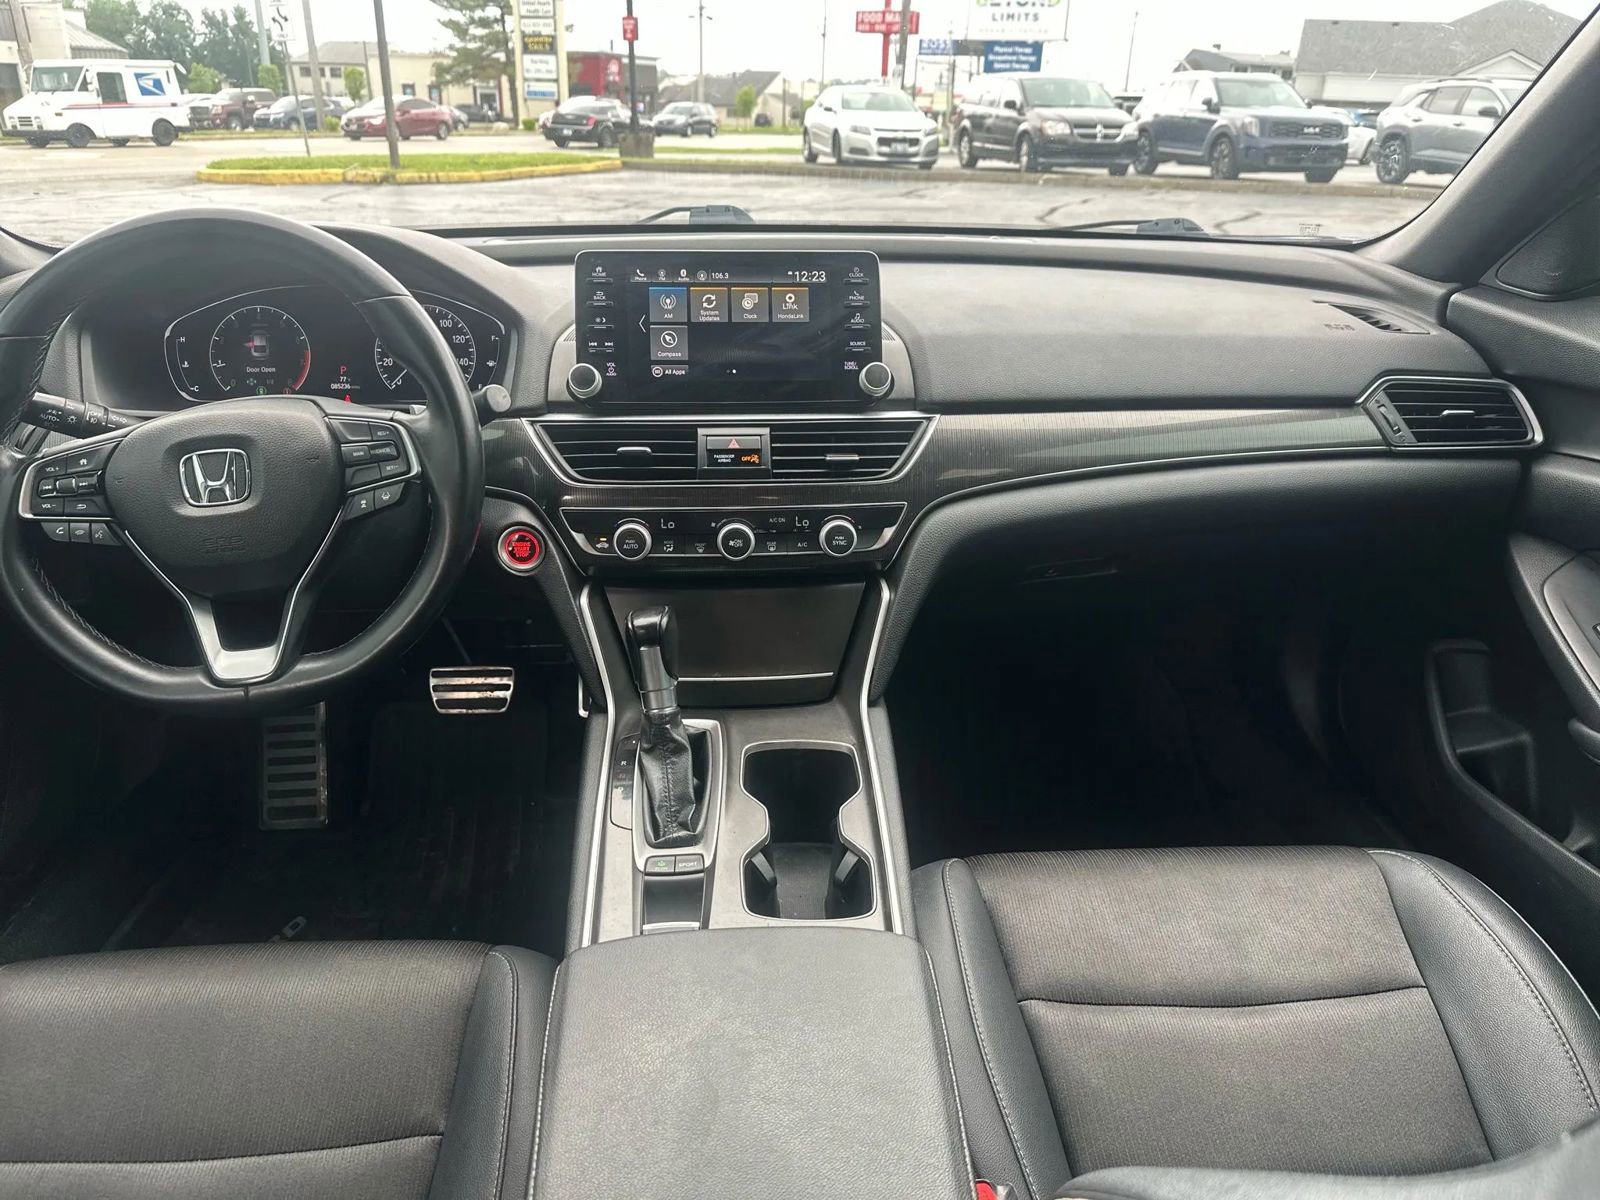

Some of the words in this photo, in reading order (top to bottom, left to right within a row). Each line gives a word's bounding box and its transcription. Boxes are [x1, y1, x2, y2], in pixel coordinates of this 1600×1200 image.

[858, 12, 883, 23] FOOD
[992, 12, 1040, 22] LIMITS
[794, 270, 826, 282] 12:23
[439, 319, 453, 328] 100
[452, 335, 466, 344] 120
[383, 357, 394, 366] 20
[260, 366, 276, 374] Open
[340, 366, 347, 375] P
[673, 368, 686, 376] Apps
[40, 413, 57, 421] AUTO
[660, 518, 675, 529] Lo
[795, 515, 810, 527] Lo
